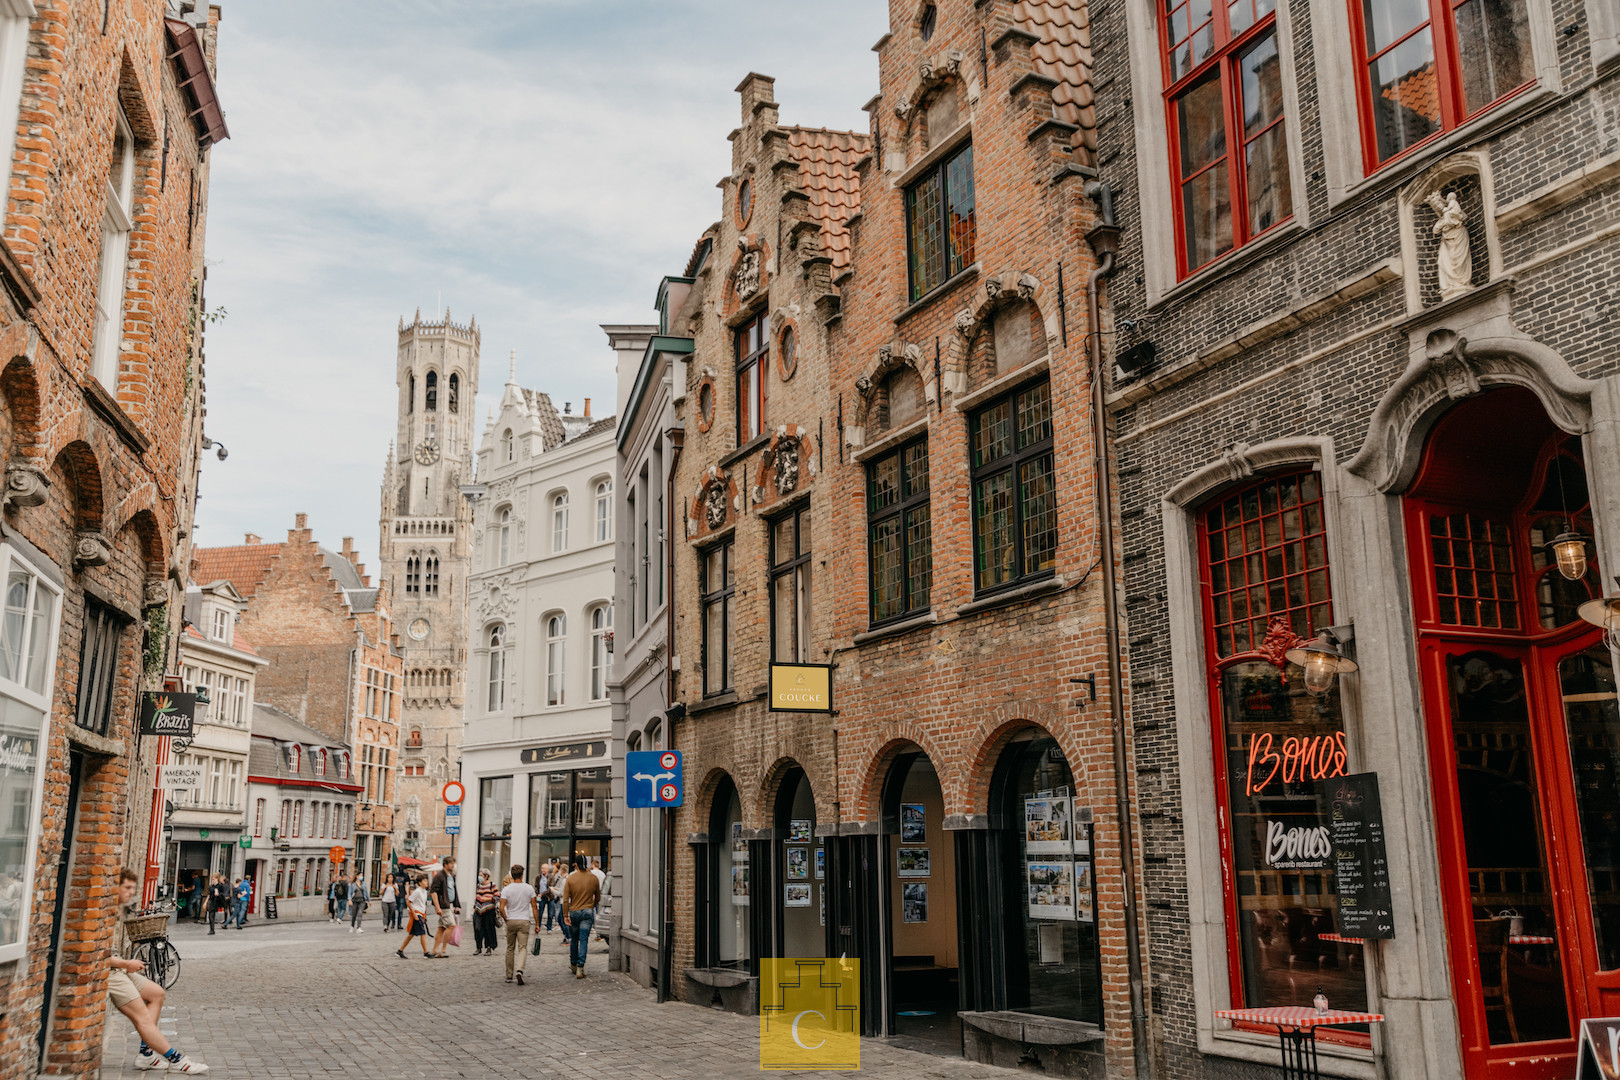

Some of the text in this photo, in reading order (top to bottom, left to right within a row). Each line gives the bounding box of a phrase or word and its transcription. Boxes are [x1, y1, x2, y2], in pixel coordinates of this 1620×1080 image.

[779, 693, 821, 702] COUCKE
[1246, 731, 1349, 797] Bones
[164, 769, 200, 777] AMERICAN
[1265, 820, 1332, 866] Bones
[1274, 860, 1323, 869] sparerib restaurant
